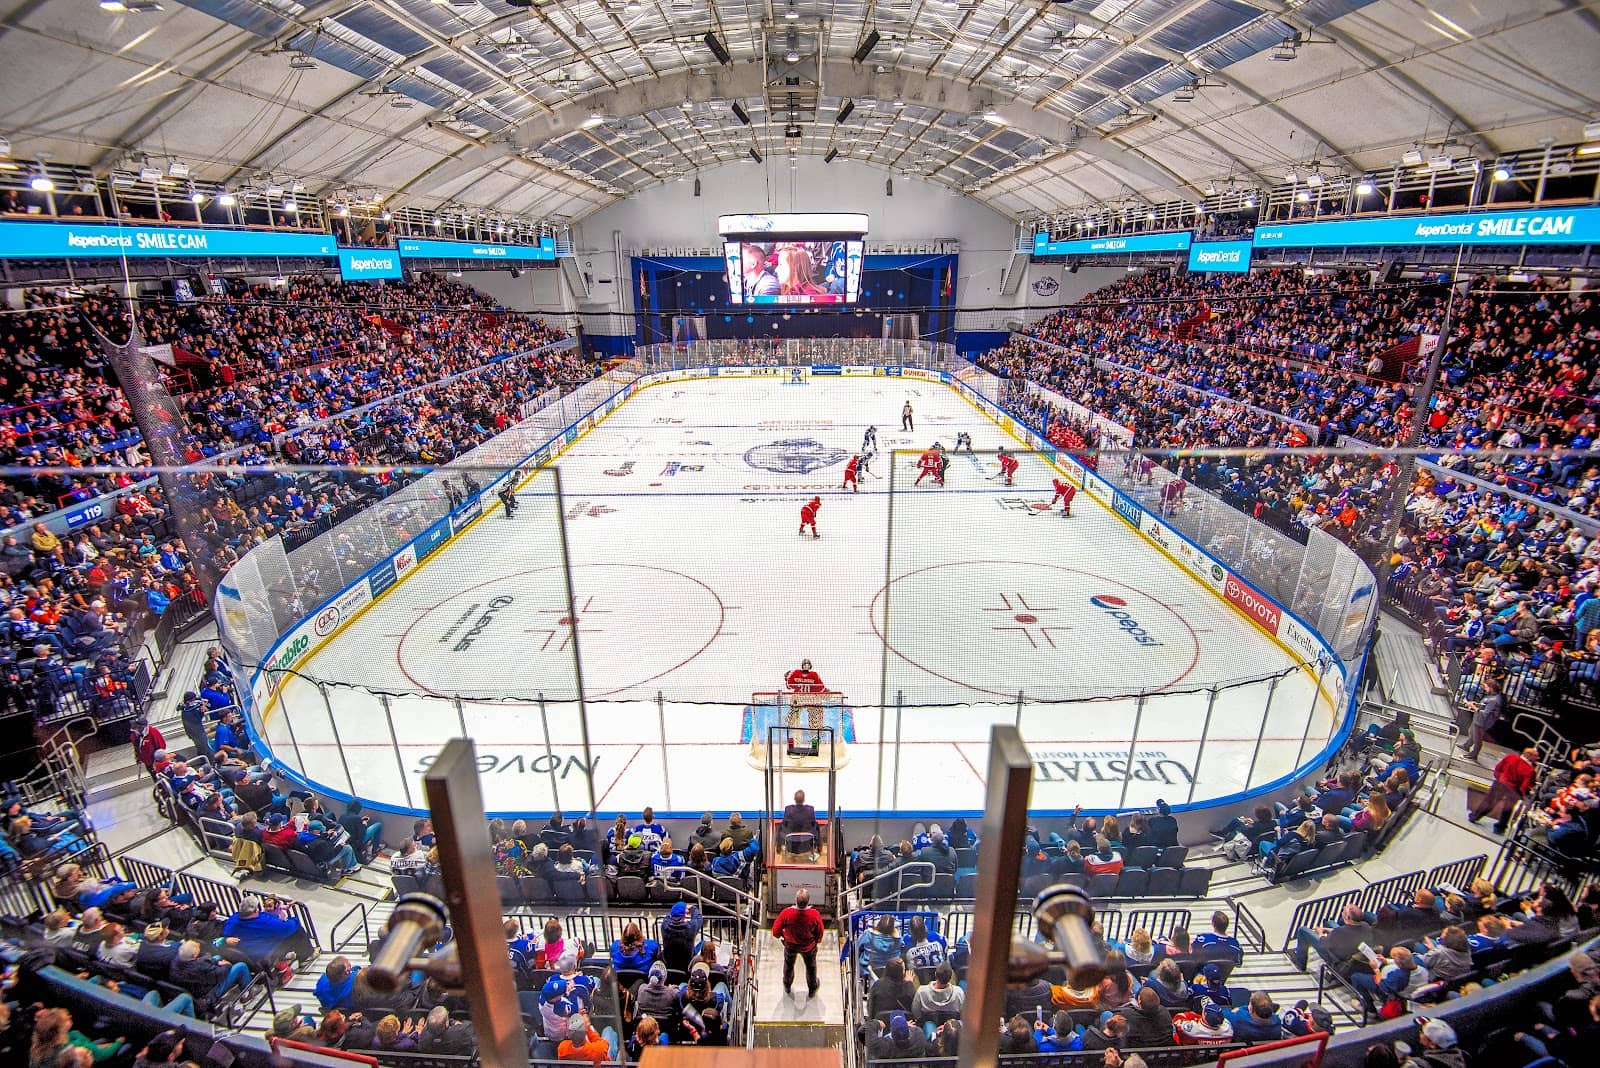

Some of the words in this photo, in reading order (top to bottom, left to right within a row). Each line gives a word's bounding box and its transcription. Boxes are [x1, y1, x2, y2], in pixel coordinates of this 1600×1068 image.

[1415, 222, 1475, 237] AspenDental
[1477, 217, 1528, 236] SMILE
[1527, 216, 1576, 234] CAM
[68, 231, 133, 247] AspenDental
[135, 232, 178, 249] SMILE
[177, 234, 208, 249] CAM
[351, 256, 393, 272] AspenDental
[1197, 249, 1240, 264] AspenDental
[84, 505, 102, 520] 119
[1240, 590, 1278, 627] TOYOTA
[1103, 611, 1165, 646] pepsi
[1034, 759, 1202, 785] UPSTAT
